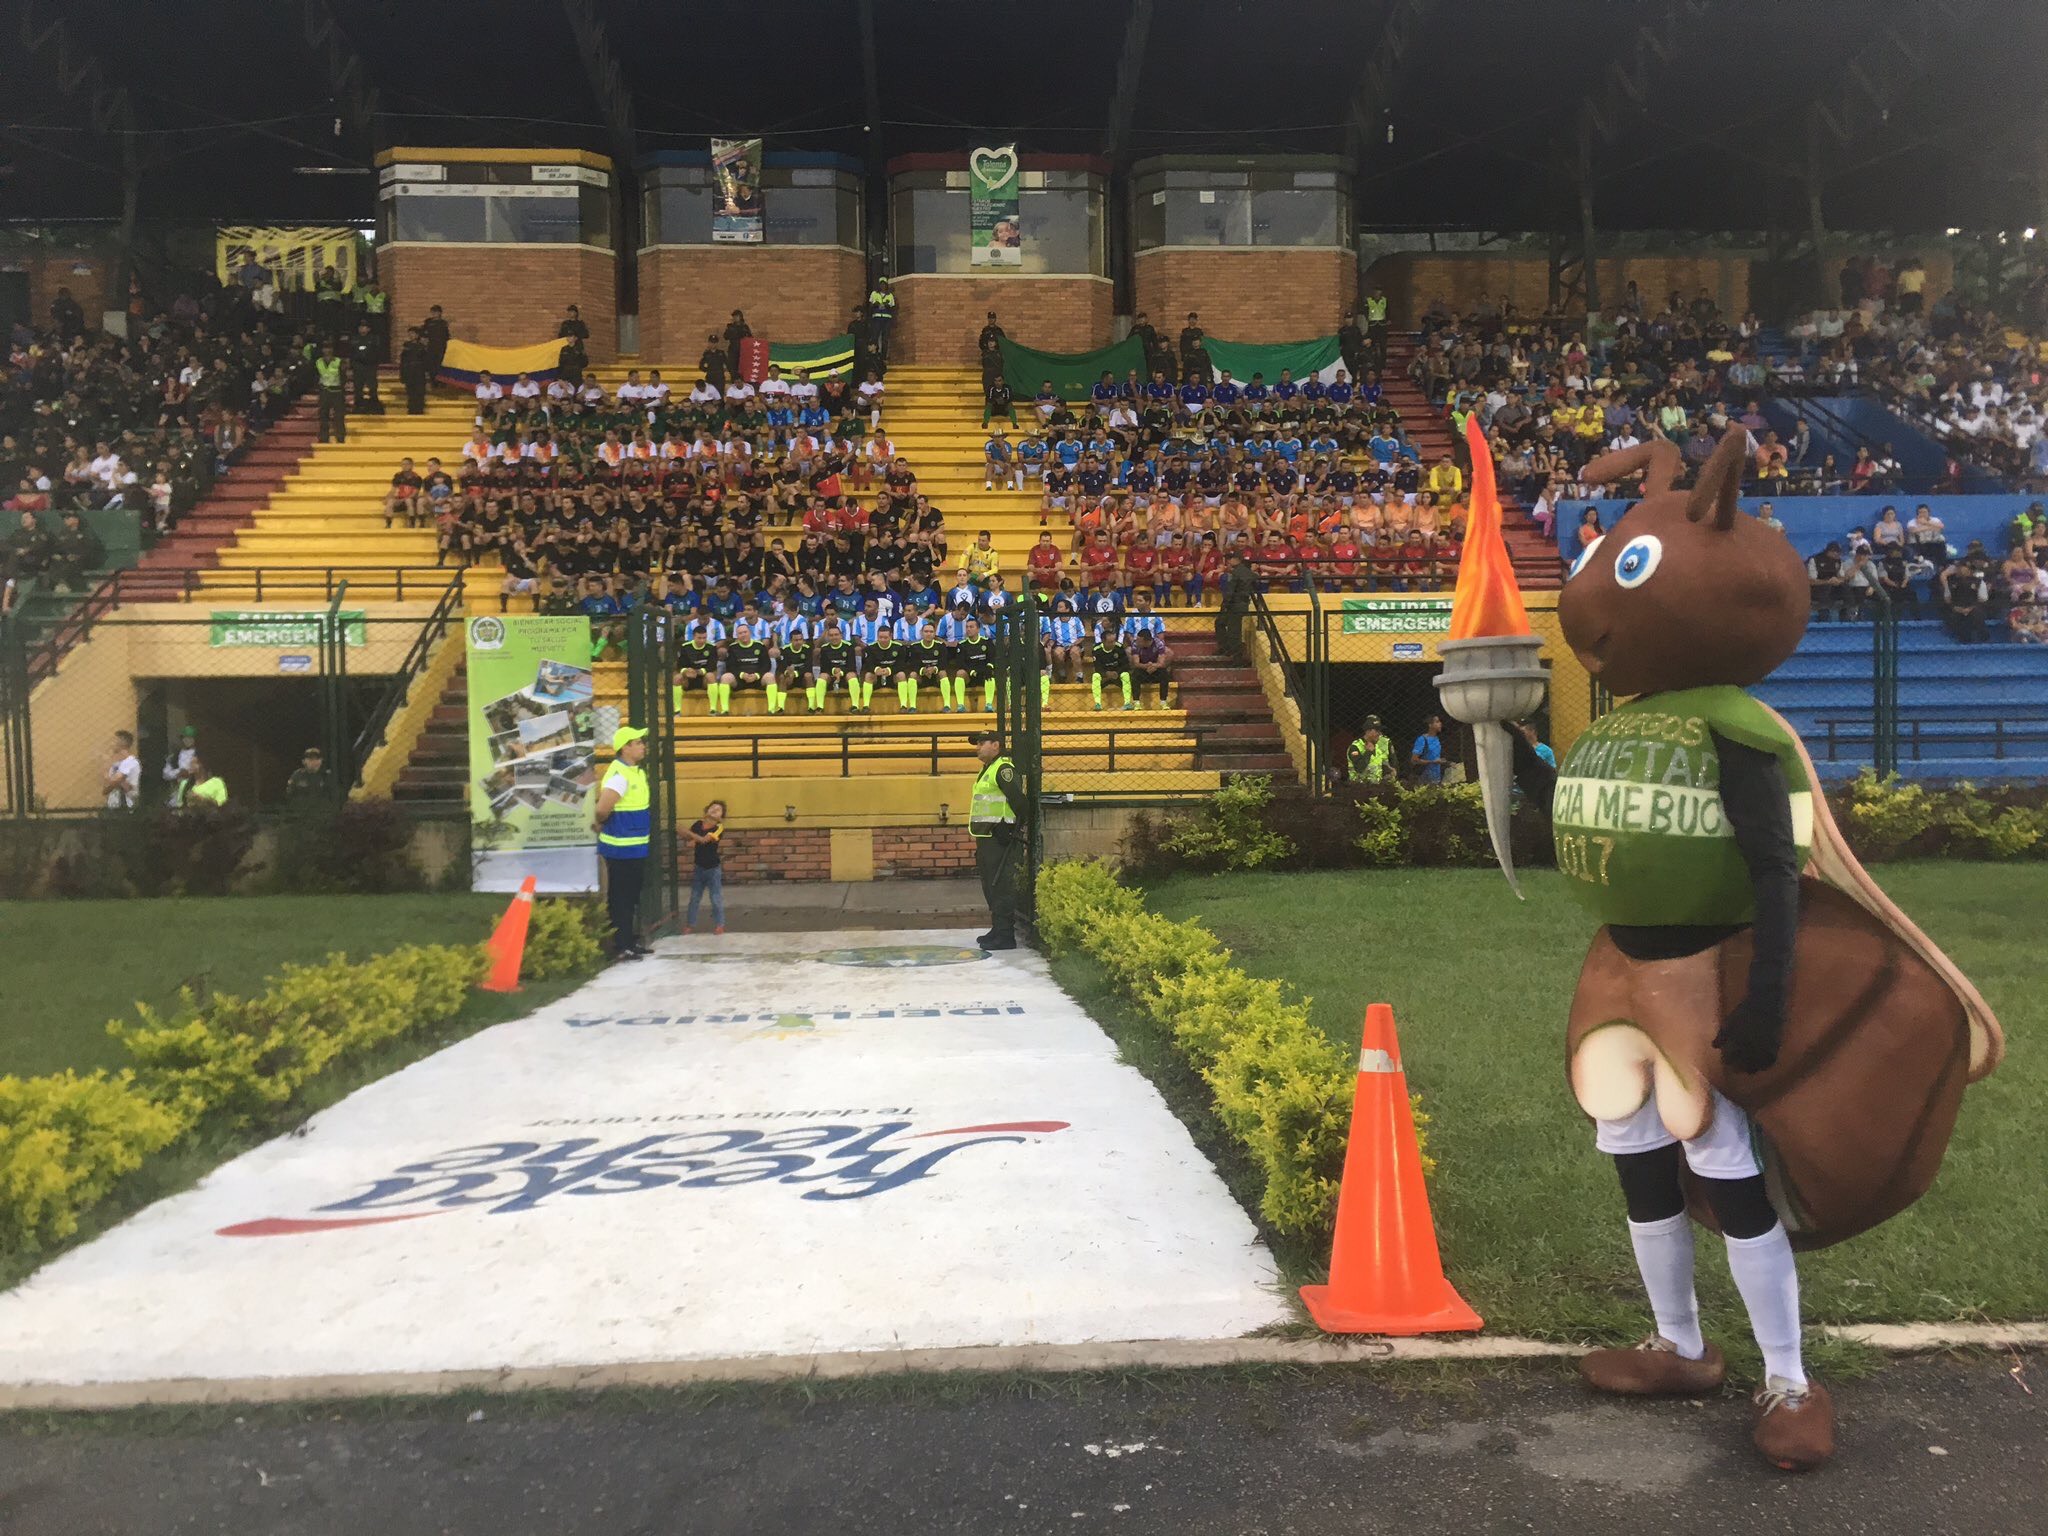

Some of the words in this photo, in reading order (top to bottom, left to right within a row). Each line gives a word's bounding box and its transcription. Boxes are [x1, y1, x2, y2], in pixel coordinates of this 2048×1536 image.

[1354, 616, 1451, 630] EMERGENC
[651, 1112, 724, 1123] con
[733, 1107, 869, 1119] deleita
[877, 1107, 919, 1116] Te
[521, 1115, 642, 1128] amor
[394, 1122, 912, 1180] leche
[311, 1136, 1025, 1215] freska
